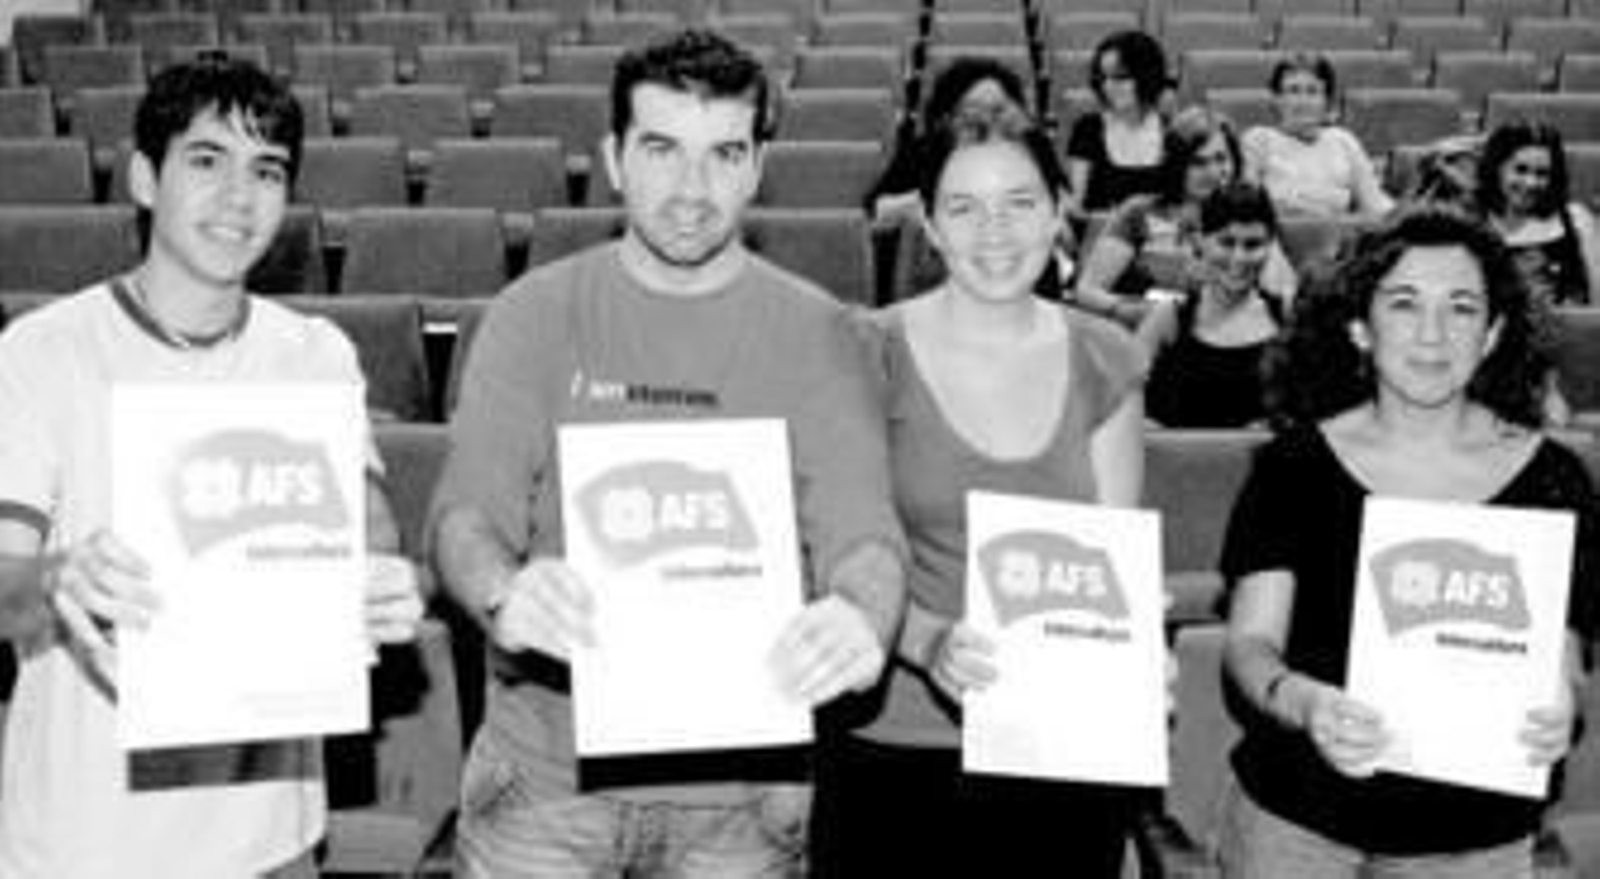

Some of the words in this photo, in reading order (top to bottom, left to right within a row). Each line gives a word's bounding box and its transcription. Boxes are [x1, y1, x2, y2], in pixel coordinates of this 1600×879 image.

[248, 458, 321, 507] AFS
[659, 492, 728, 531] AFS
[1047, 562, 1107, 597] AFS
[1444, 570, 1510, 608] AFS
